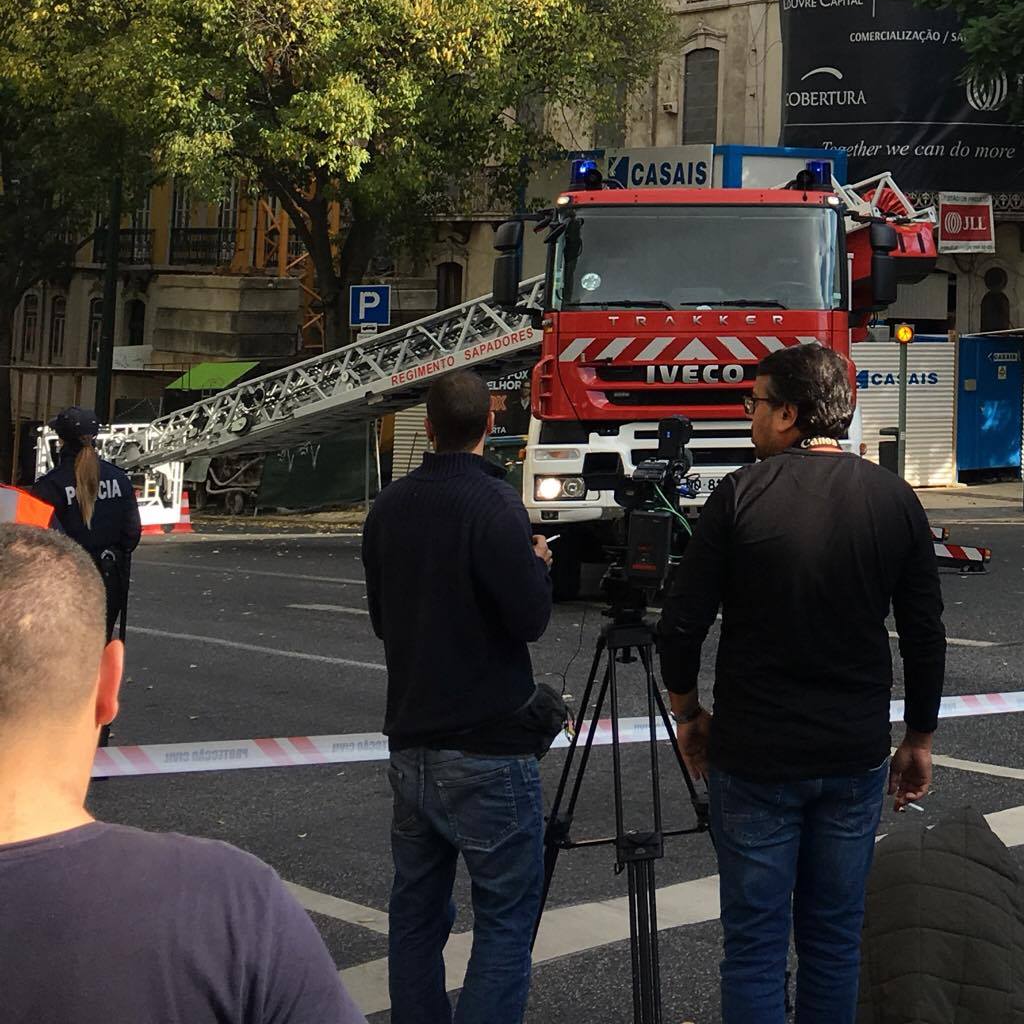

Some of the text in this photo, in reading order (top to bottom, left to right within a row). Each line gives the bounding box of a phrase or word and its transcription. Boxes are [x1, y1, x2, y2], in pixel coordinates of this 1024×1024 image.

[850, 29, 941, 44] COMERCIALIZAÇÃO
[950, 32, 967, 42] SA
[785, 89, 867, 107] OBERTURA
[886, 143, 909, 156] we
[914, 144, 945, 157] can
[949, 140, 970, 158] do
[974, 146, 1016, 160] more
[631, 161, 707, 186] CASAIS
[962, 215, 988, 231] JLL
[359, 291, 381, 320] P
[608, 315, 785, 325] TRAKKER
[391, 327, 534, 386] REGIMENTO SAPADORES
[646, 363, 745, 384] IVECO
[871, 372, 939, 385] CAAIS
[487, 380, 522, 391] ELHOR
[65, 479, 122, 506] PCIA
